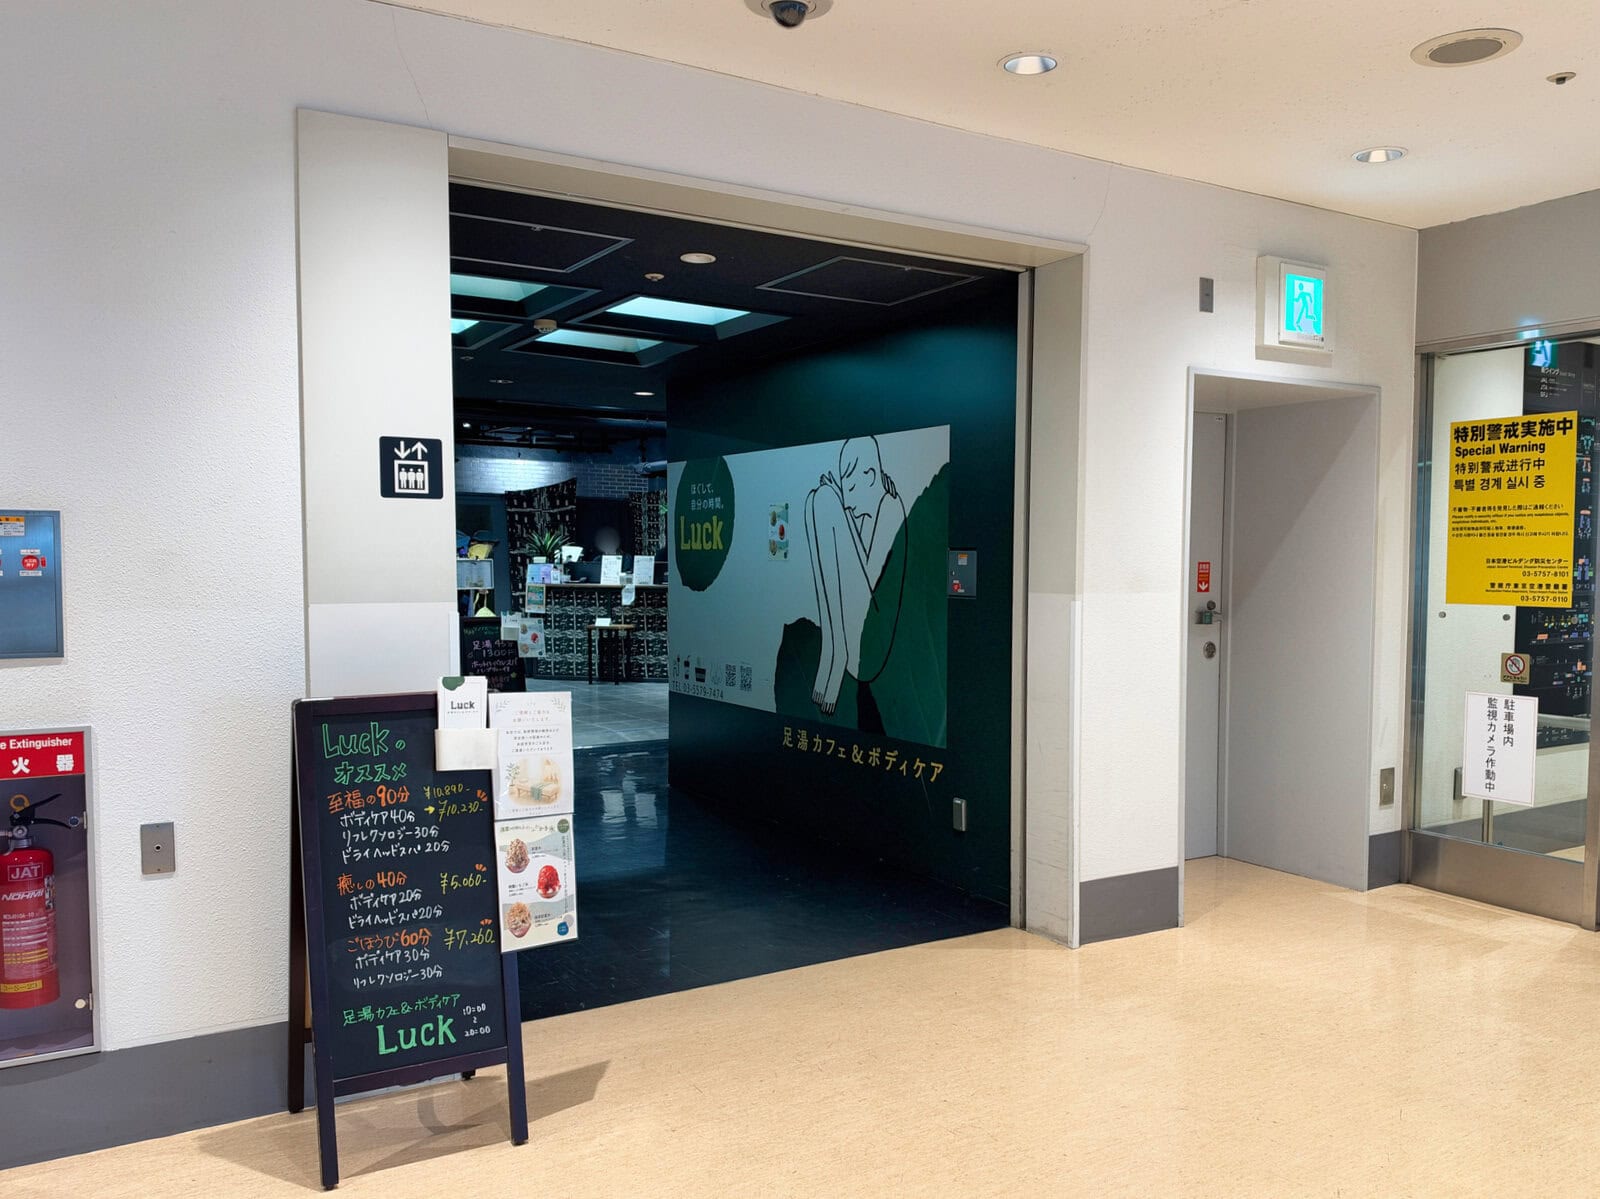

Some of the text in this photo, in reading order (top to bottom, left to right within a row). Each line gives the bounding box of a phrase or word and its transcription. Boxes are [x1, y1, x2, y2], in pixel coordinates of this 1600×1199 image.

[1453, 417, 1573, 443] 特別警戒実施中
[1455, 441, 1546, 458] Special Warning
[1455, 457, 1545, 475] 特别警戒进行中
[1480, 477, 1502, 490] 경계
[1506, 476, 1528, 490] 실시
[1533, 475, 1546, 488] 중
[679, 514, 723, 551] Luck
[1520, 595, 1568, 603] 03-5757-0110
[450, 700, 475, 709] Luck
[1503, 698, 1515, 747] 駐車場内
[9, 736, 73, 750] Extinguisher
[322, 721, 390, 759] Luck
[1485, 697, 1498, 792] 監視カメラ作動中
[334, 761, 408, 785] オススメ
[327, 784, 410, 814] 至福の90分
[340, 808, 416, 828] ボディケア40分
[342, 825, 440, 847] リフレクソロジー30分
[10, 864, 41, 880] JAT
[336, 871, 408, 896] 癒しの40分
[2, 888, 44, 901] NOHMI
[349, 888, 423, 911] ボディケア20分
[347, 927, 433, 953] ごほうび60分
[355, 947, 431, 970] ボディケア30分
[353, 964, 444, 989] リフレクソロジー30分
[375, 1014, 457, 1055] Luck
